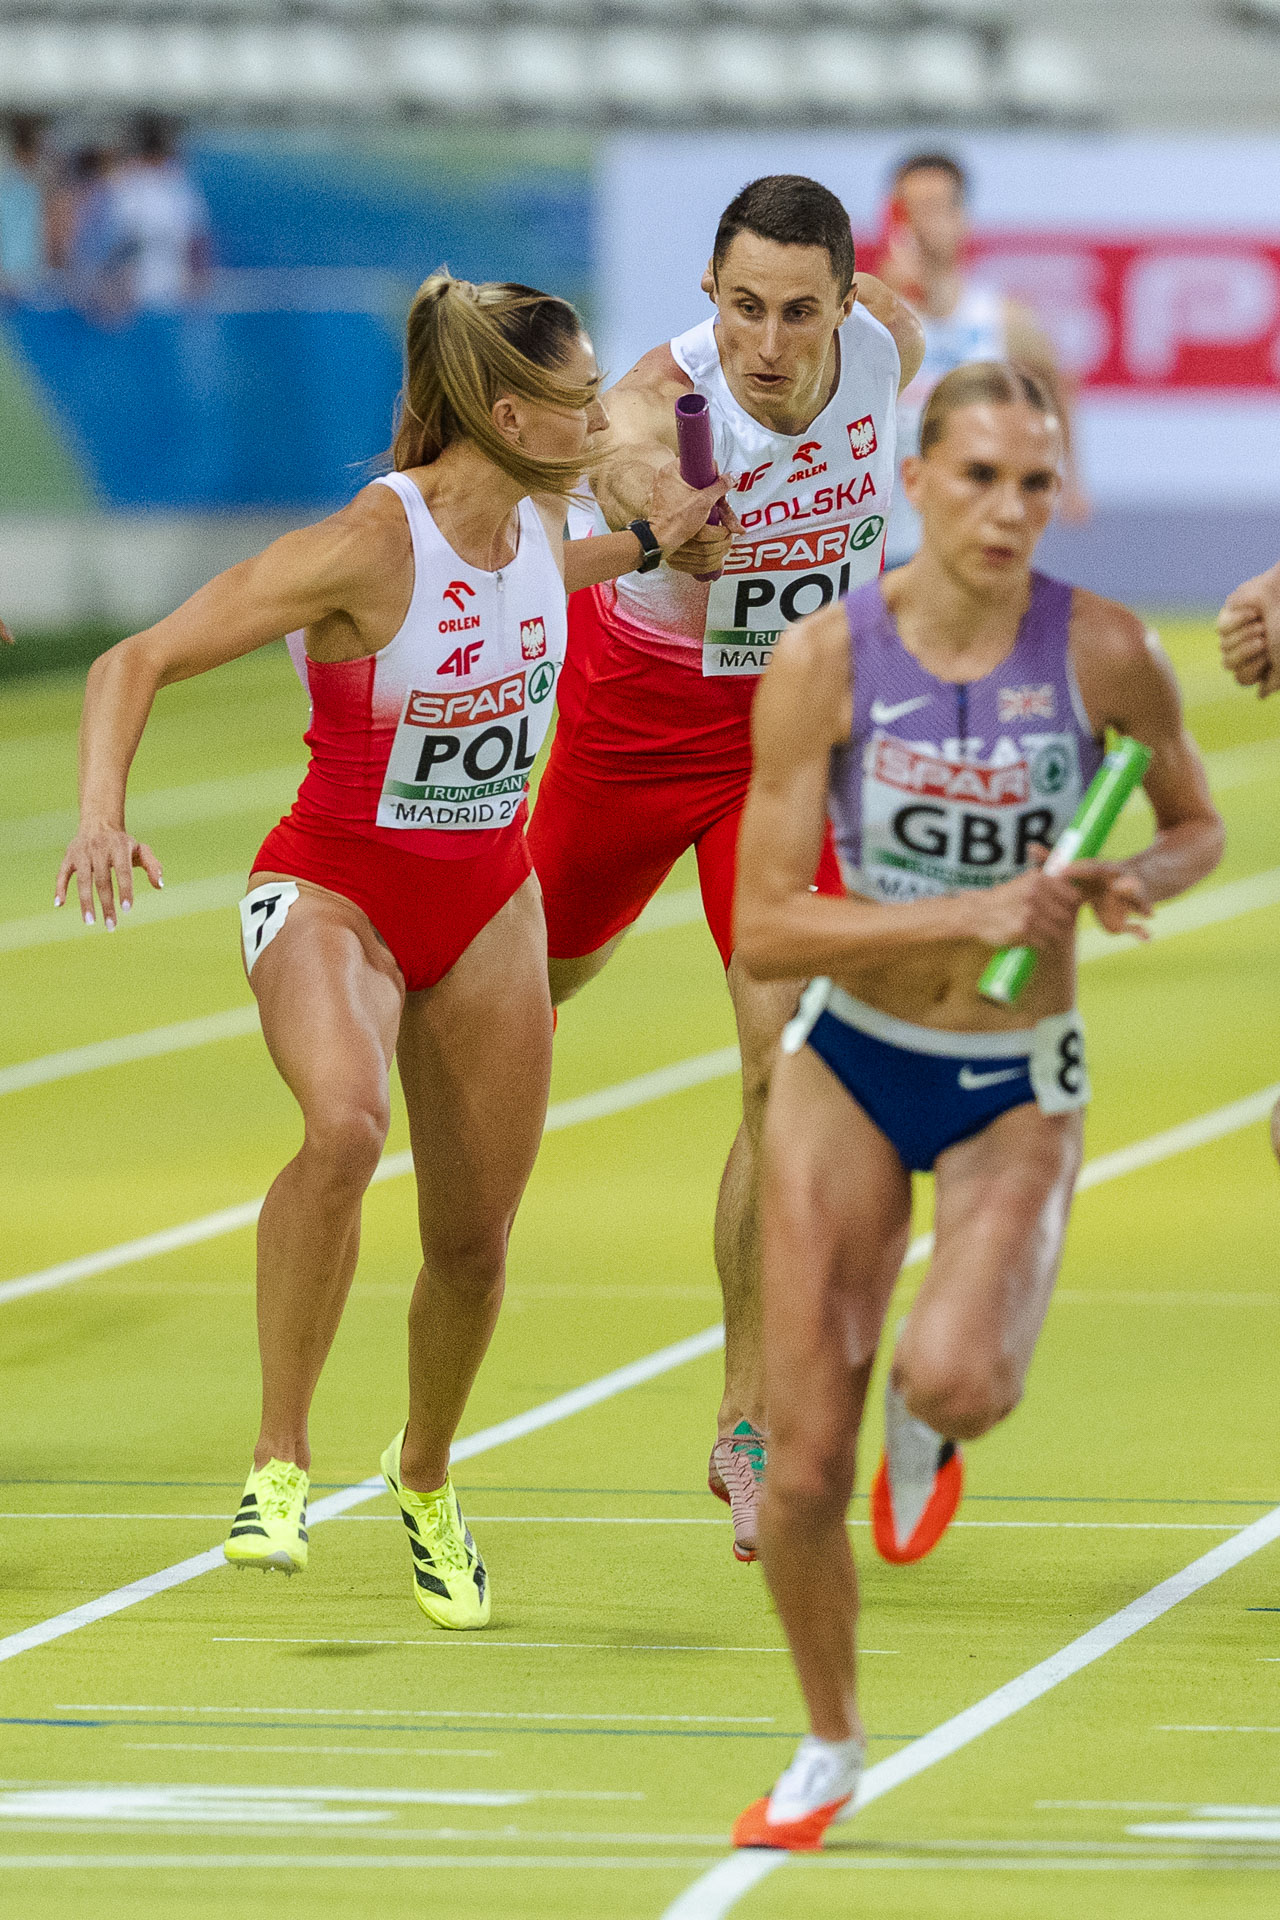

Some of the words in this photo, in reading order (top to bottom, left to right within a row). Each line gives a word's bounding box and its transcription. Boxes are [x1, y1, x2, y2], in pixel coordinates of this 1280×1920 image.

[965, 252, 1280, 376] SP
[787, 461, 828, 484] ORLEN
[740, 472, 877, 529] POLSKA
[723, 530, 848, 571] SPAR
[438, 615, 481, 634] ORLEN
[745, 632, 751, 644] I
[754, 632, 780, 645] RU
[436, 639, 485, 677] 4F
[719, 651, 775, 667] MAD
[409, 679, 523, 725] SPAR
[414, 716, 537, 782] POL
[424, 787, 431, 799] I
[433, 787, 472, 801] RUN
[474, 775, 523, 798] CLEAN
[395, 803, 494, 824] MADRID
[892, 802, 1056, 867] GBR
[251, 893, 282, 952] 7
